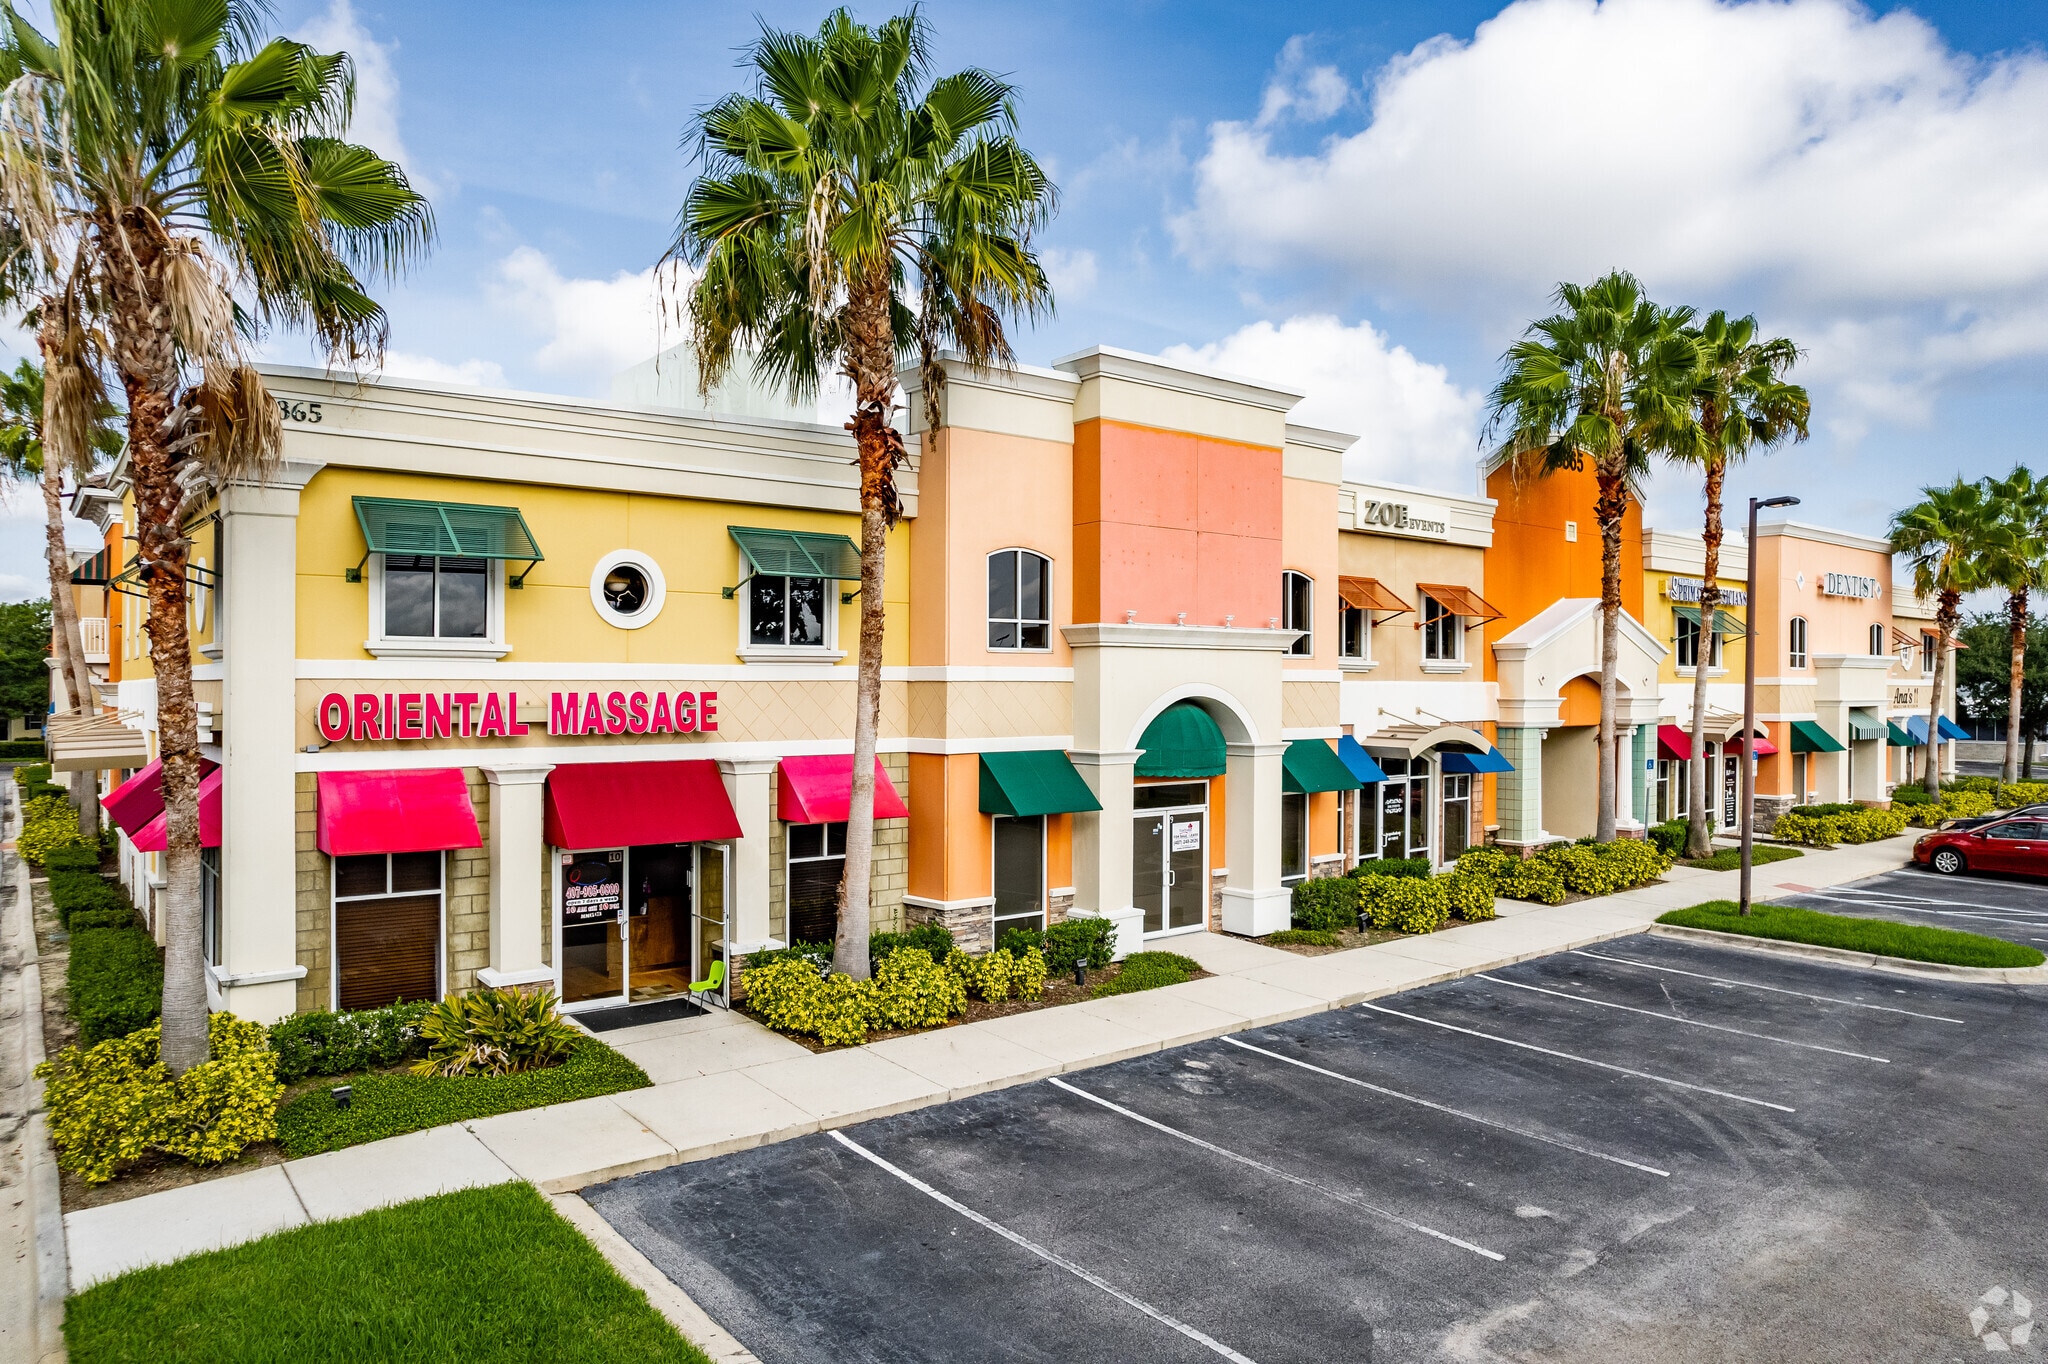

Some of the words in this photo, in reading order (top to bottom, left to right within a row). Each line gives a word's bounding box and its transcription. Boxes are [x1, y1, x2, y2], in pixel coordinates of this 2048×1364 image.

[1365, 500, 1408, 528] ZOE
[1409, 518, 1445, 533] EVENTS
[1678, 584, 1702, 602] PRIMA
[1826, 572, 1876, 598] DENTIST
[1893, 687, 1913, 704] Ana's
[317, 692, 529, 741] ORIENTAL
[547, 691, 719, 738] MASSAGE
[610, 852, 621, 861] 10
